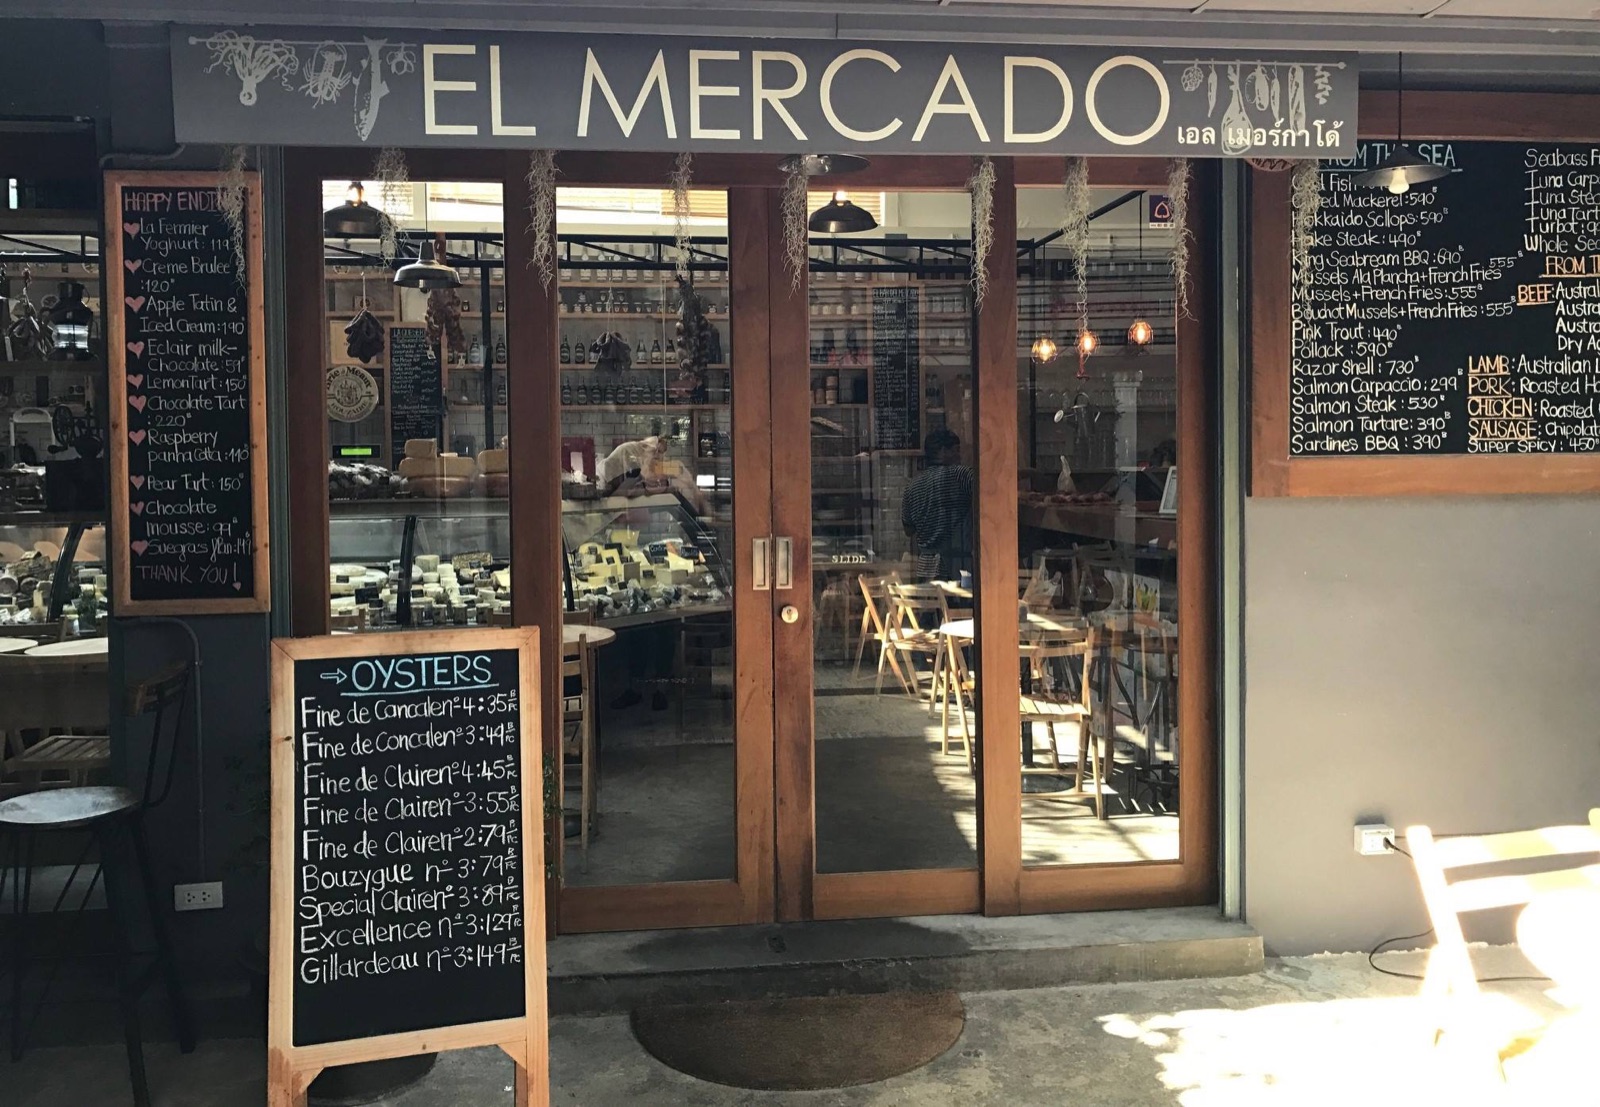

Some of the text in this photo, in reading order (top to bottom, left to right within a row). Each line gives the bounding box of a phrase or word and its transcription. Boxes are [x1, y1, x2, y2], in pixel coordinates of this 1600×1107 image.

[423, 44, 1170, 145] EL MERCADO
[1177, 125, 1216, 145] เอล
[1418, 144, 1456, 167] SEA
[1524, 148, 1588, 167] Seabass
[1525, 169, 1564, 189] Tuna
[124, 192, 172, 212] HAPPY
[1525, 186, 1565, 205] Tuna
[1524, 201, 1567, 221] Tuna
[140, 218, 209, 236] La Fermier
[1524, 234, 1568, 254] Whole
[142, 256, 231, 274] Creme Brulee
[1327, 251, 1400, 268] Seabream
[1545, 255, 1586, 275] FROM
[1292, 267, 1348, 286] Mussels
[146, 293, 238, 317] Apple Tatin &
[139, 316, 174, 333] Iced
[1292, 320, 1322, 341] Pink
[147, 339, 193, 356] Eclair
[1292, 338, 1344, 358] Pollack
[1558, 334, 1583, 354] Dry
[1292, 358, 1339, 376] Razor
[1341, 357, 1375, 376] Shell
[1517, 354, 1591, 376] Australian
[1292, 377, 1348, 396] Salmon
[1520, 376, 1580, 395] Roasted
[148, 394, 247, 411] Chocolate Tart
[1292, 396, 1350, 415] Salmon
[1355, 395, 1396, 413] Steak
[1540, 398, 1594, 418] Roasted
[1292, 415, 1353, 433] Salmon
[148, 428, 218, 451] Raspberry
[1292, 435, 1358, 453] Sardines
[1365, 435, 1400, 451] BBQ
[147, 475, 177, 491] Pear
[146, 497, 217, 515] Chocolate
[831, 555, 867, 564] SLIDE
[136, 564, 192, 584] THANK
[352, 654, 492, 691] OYSTERS
[301, 696, 344, 729] Fine
[347, 701, 372, 724] de
[302, 731, 347, 761] Fine
[351, 732, 373, 755] de
[303, 762, 351, 795] Fine
[355, 766, 378, 792] de
[303, 797, 349, 826] Fine
[354, 798, 378, 823] de
[302, 829, 348, 861] Fine
[353, 830, 378, 859] de
[302, 862, 414, 893] Bouzygue
[299, 888, 376, 927] Special
[300, 919, 432, 954] Excellence
[300, 951, 419, 984] Gillardeau
